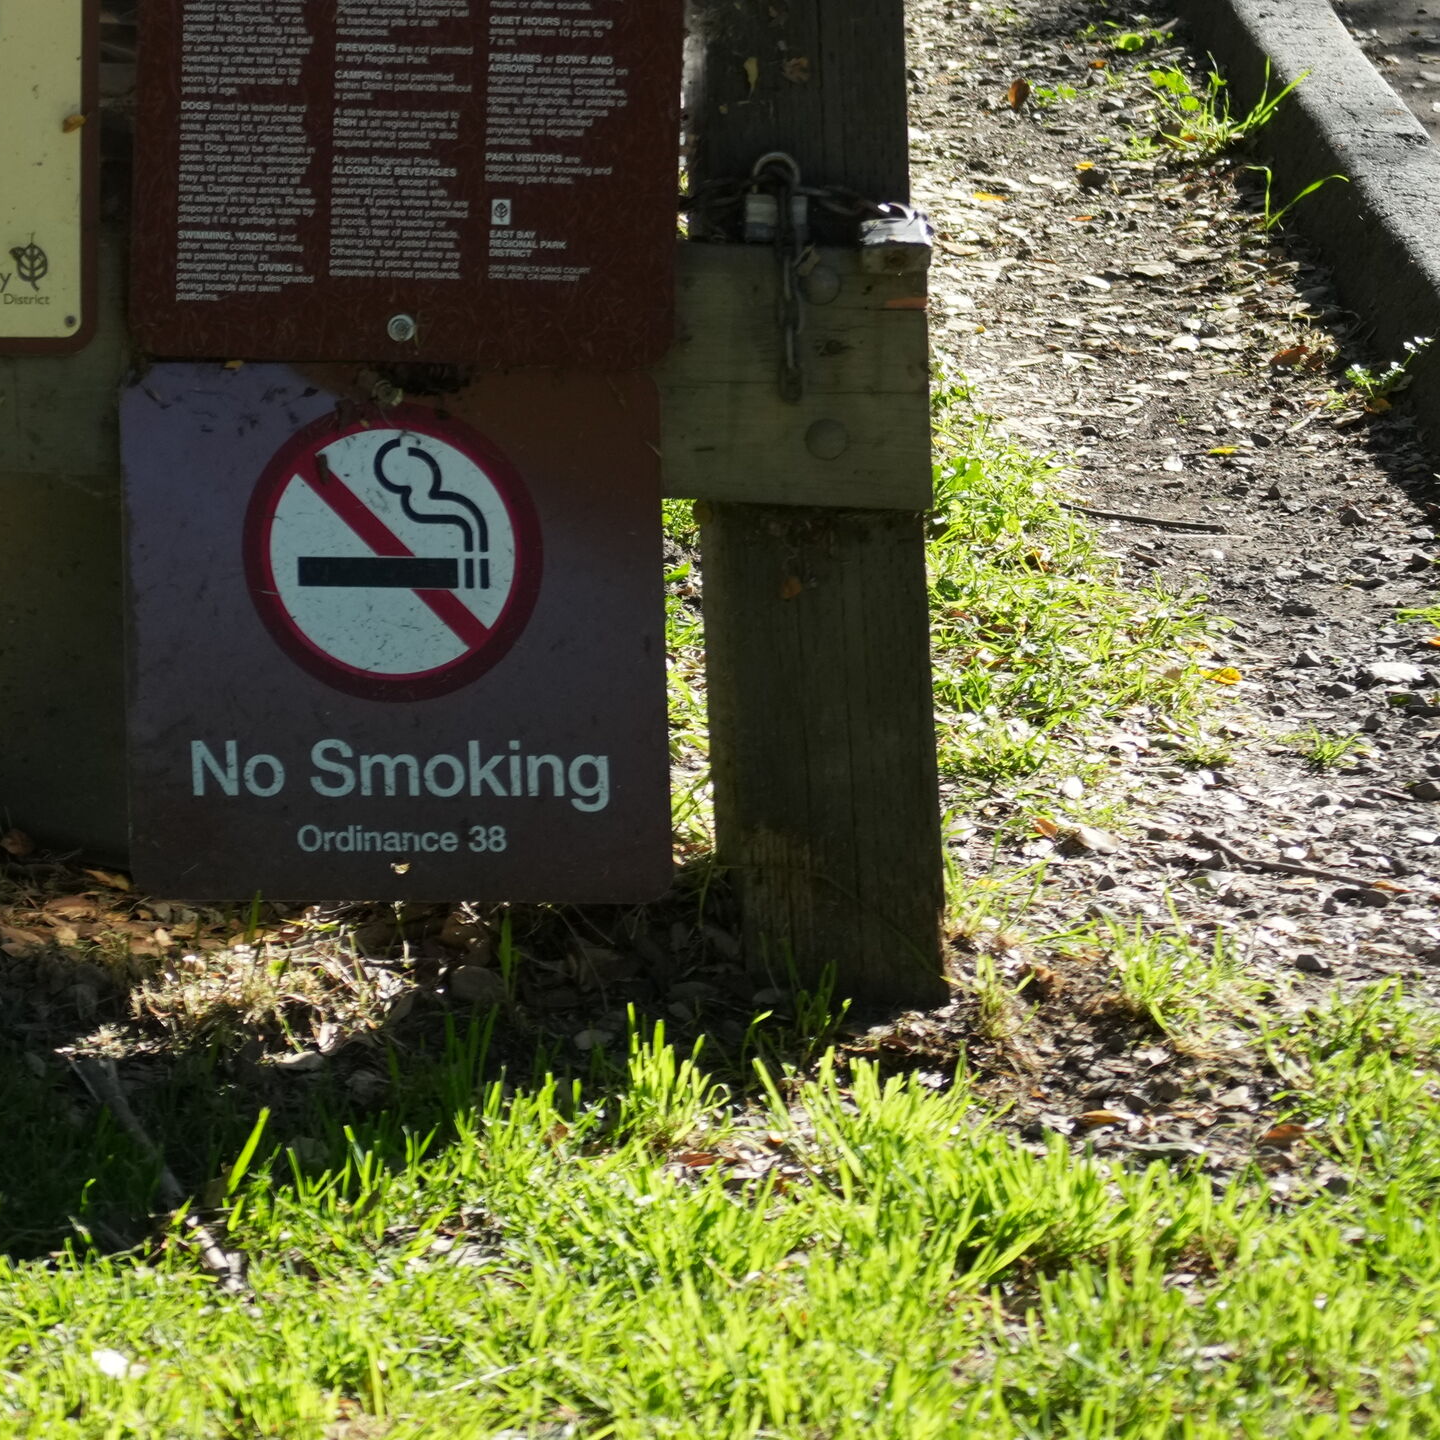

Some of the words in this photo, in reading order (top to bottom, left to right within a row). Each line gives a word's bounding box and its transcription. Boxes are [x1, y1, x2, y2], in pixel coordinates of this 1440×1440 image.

[490, 16, 521, 25] QUIET
[523, 17, 561, 26] HOURS
[336, 43, 397, 53] FIREWORKS
[489, 53, 542, 63] FIREARMS
[556, 55, 588, 64] BOWS
[591, 56, 613, 65] AND
[489, 64, 534, 73] ARROWS
[335, 70, 383, 80] CAMPING
[181, 101, 211, 110] DOGS
[486, 153, 514, 162] PARK
[515, 154, 563, 163] VISITORS
[333, 166, 392, 176] ALCOHOLIC
[394, 167, 457, 177] BEVERAGES
[235, 232, 277, 241] WADING
[490, 230, 515, 239] EAST
[516, 230, 536, 239] BAY
[489, 239, 538, 248] REGIONAL
[540, 240, 566, 249] PARK
[489, 248, 532, 257] DISTRICT
[3, 293, 50, 305] District
[190, 740, 285, 797] No
[310, 739, 610, 812] Smoking
[297, 824, 458, 853] Ordinance
[469, 826, 507, 852] 38
